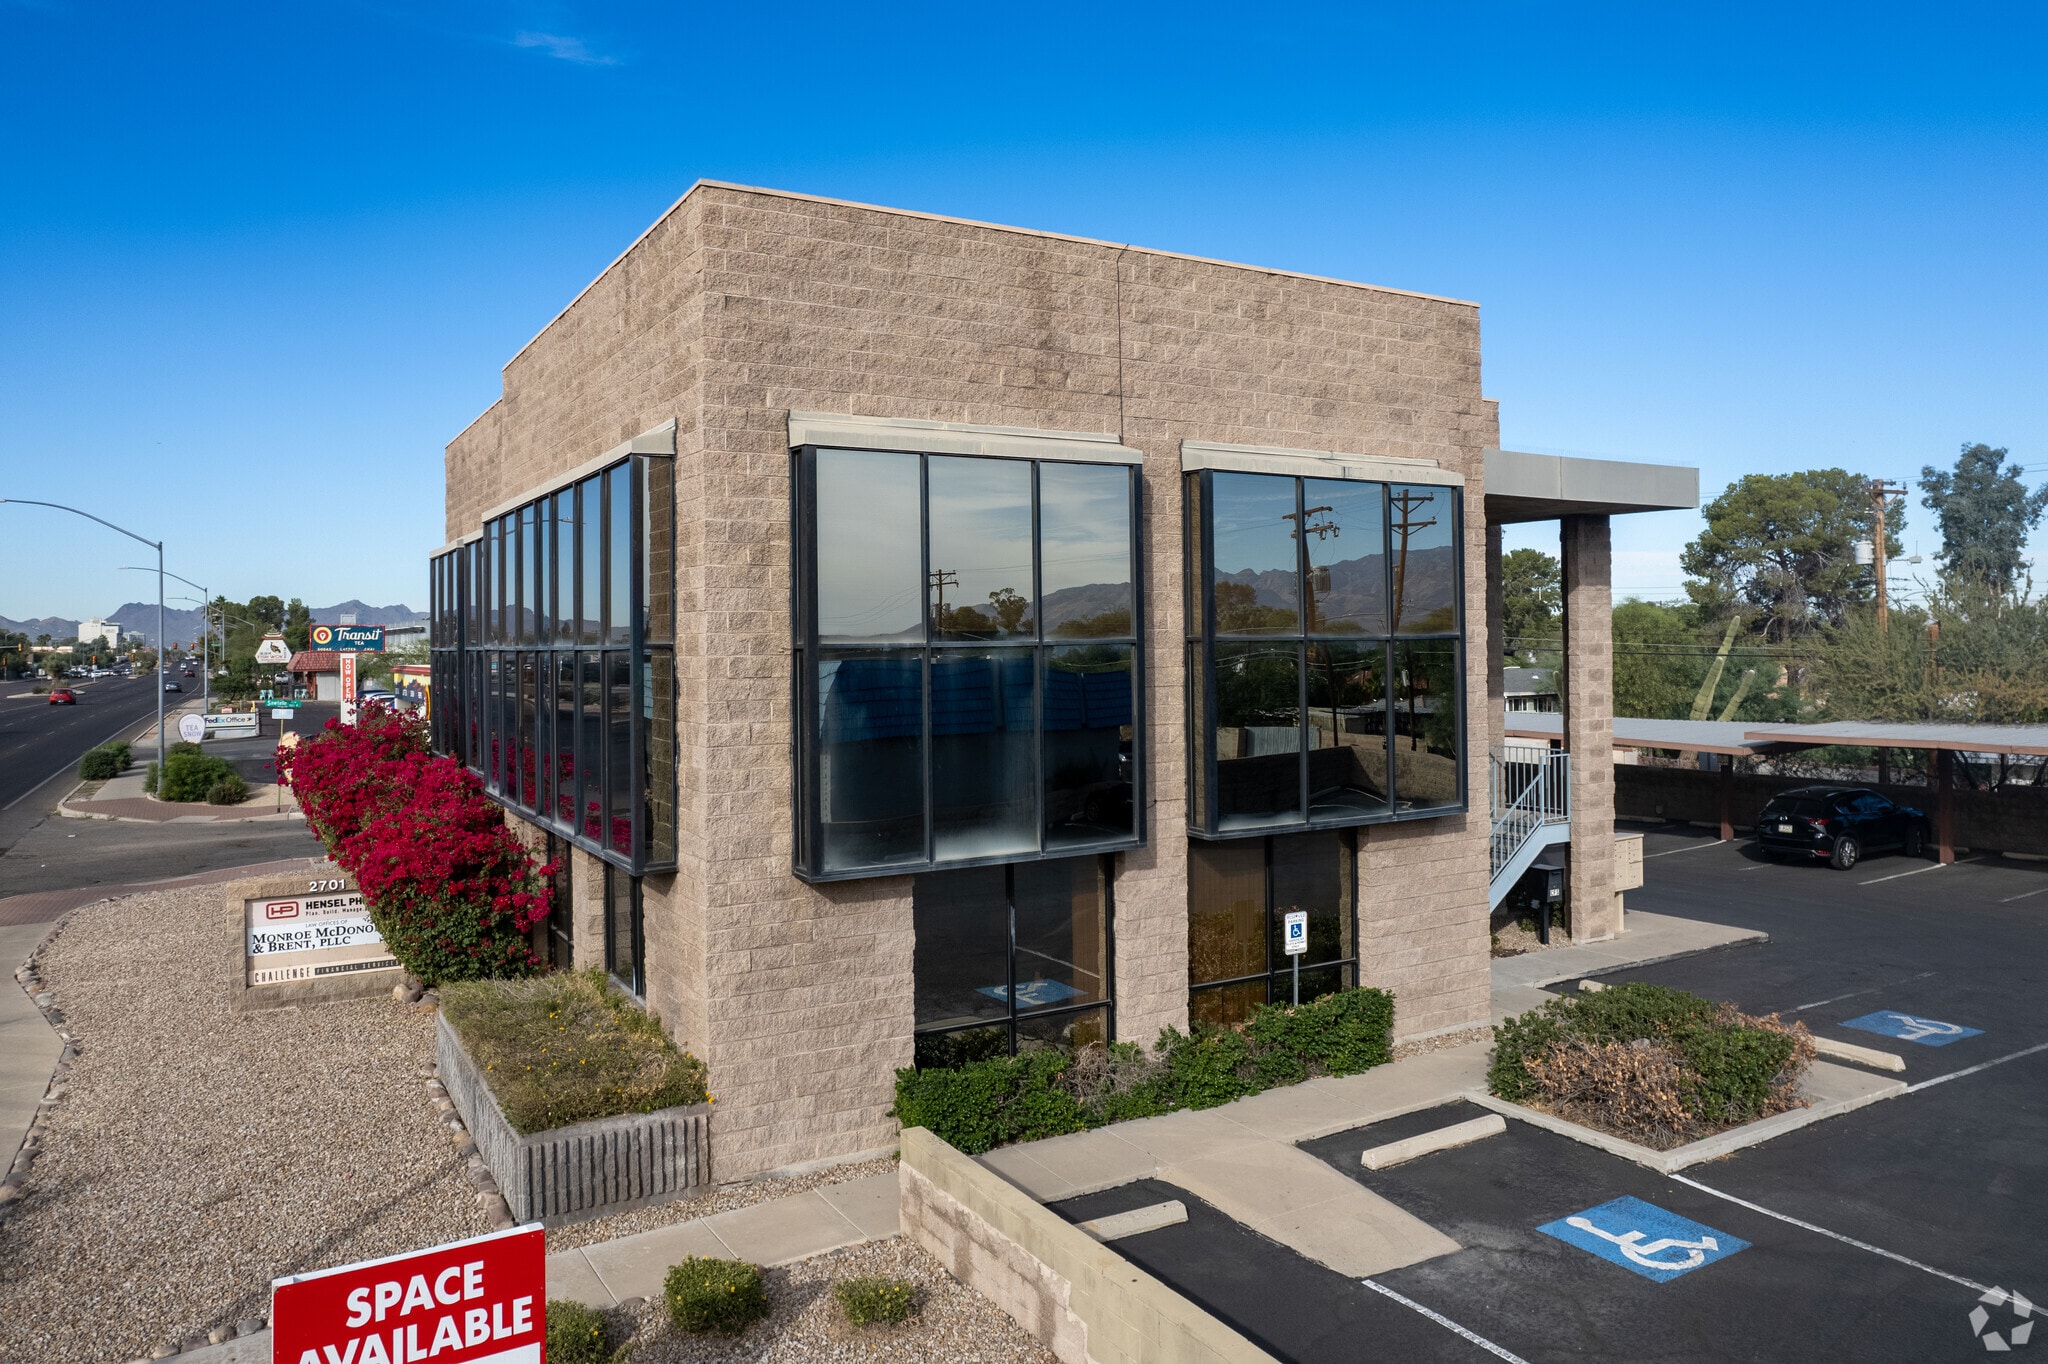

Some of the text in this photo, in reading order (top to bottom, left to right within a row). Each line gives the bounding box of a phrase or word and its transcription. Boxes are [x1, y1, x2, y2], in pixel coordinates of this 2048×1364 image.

[335, 627, 382, 641] Transit
[309, 879, 346, 892] 2701
[306, 897, 362, 910] HENSEL PH
[252, 925, 374, 945] MONROE McDONO
[252, 936, 351, 954] & BRENT, PLLC
[255, 959, 400, 983] CHALLENGE FINANCIAL SERVICES
[346, 1260, 484, 1328] SPACE
